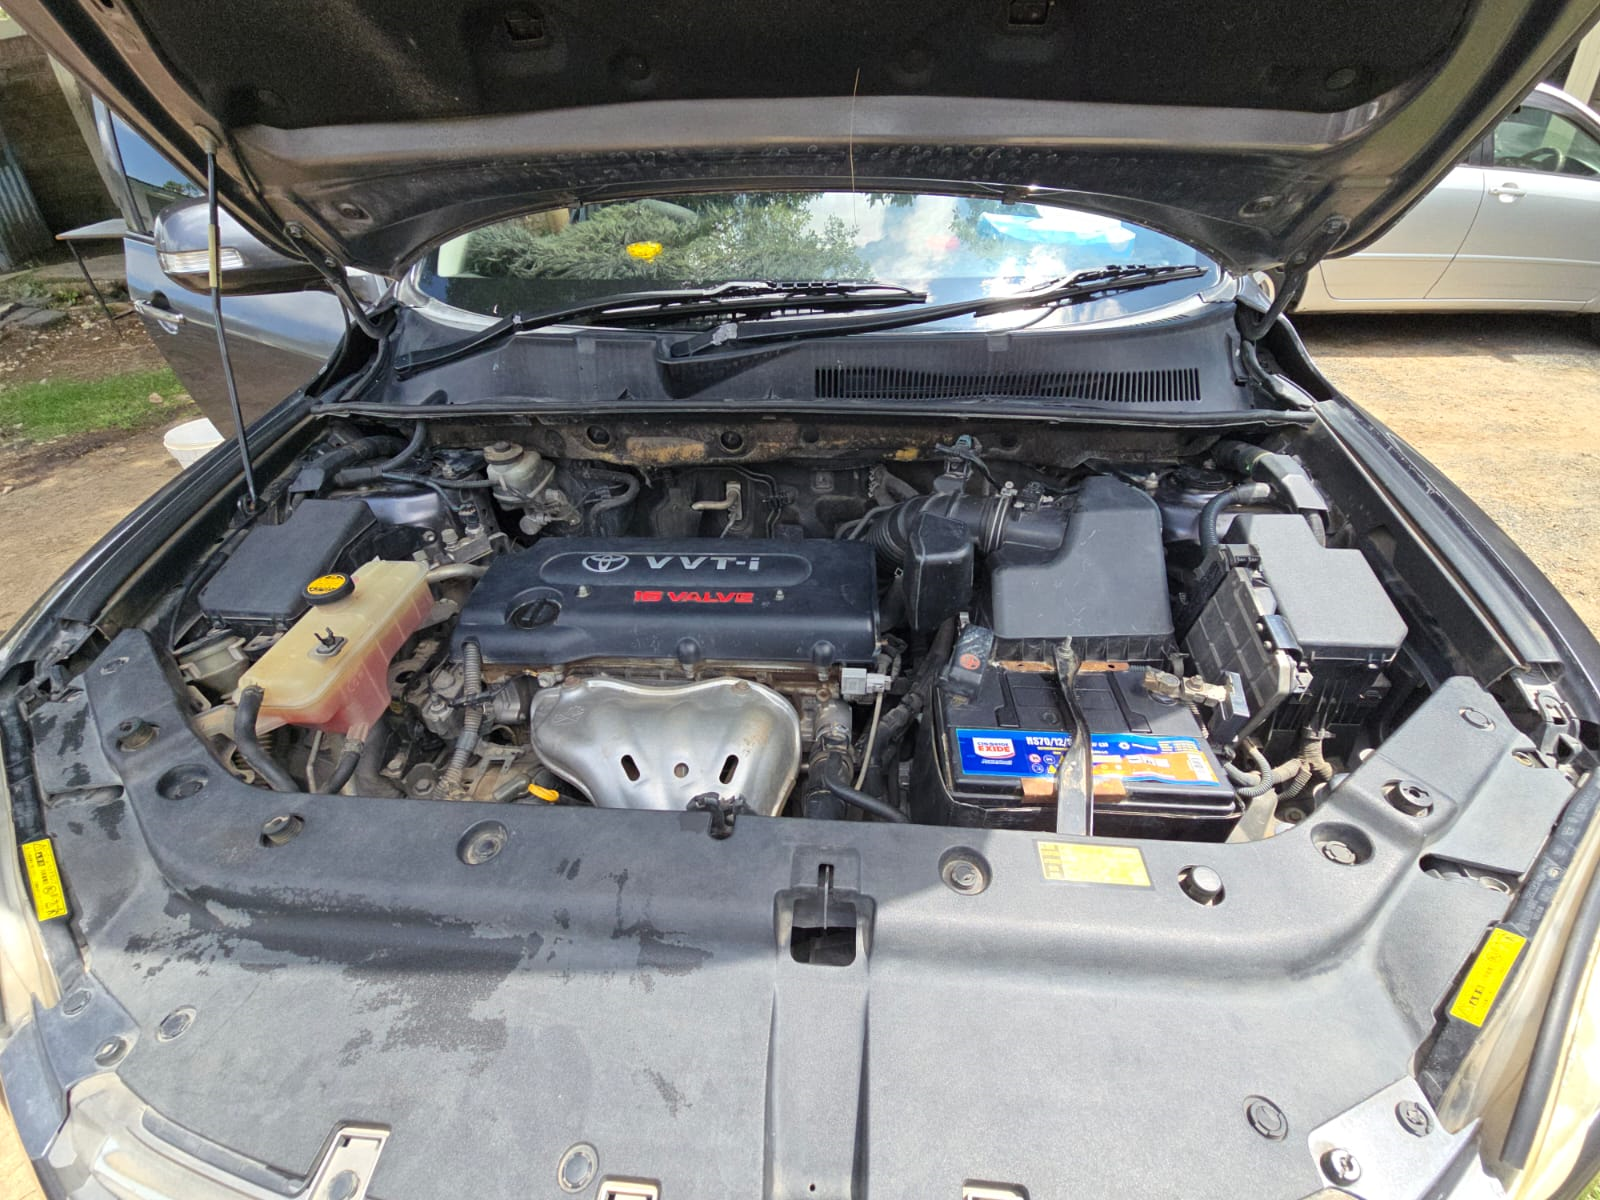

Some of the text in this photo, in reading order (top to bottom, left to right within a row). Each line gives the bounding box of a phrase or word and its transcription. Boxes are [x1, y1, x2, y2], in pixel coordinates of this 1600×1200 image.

[646, 556, 760, 571] VVT-i
[633, 590, 755, 603] 16 VALVE
[977, 745, 1011, 753] EXIDE
